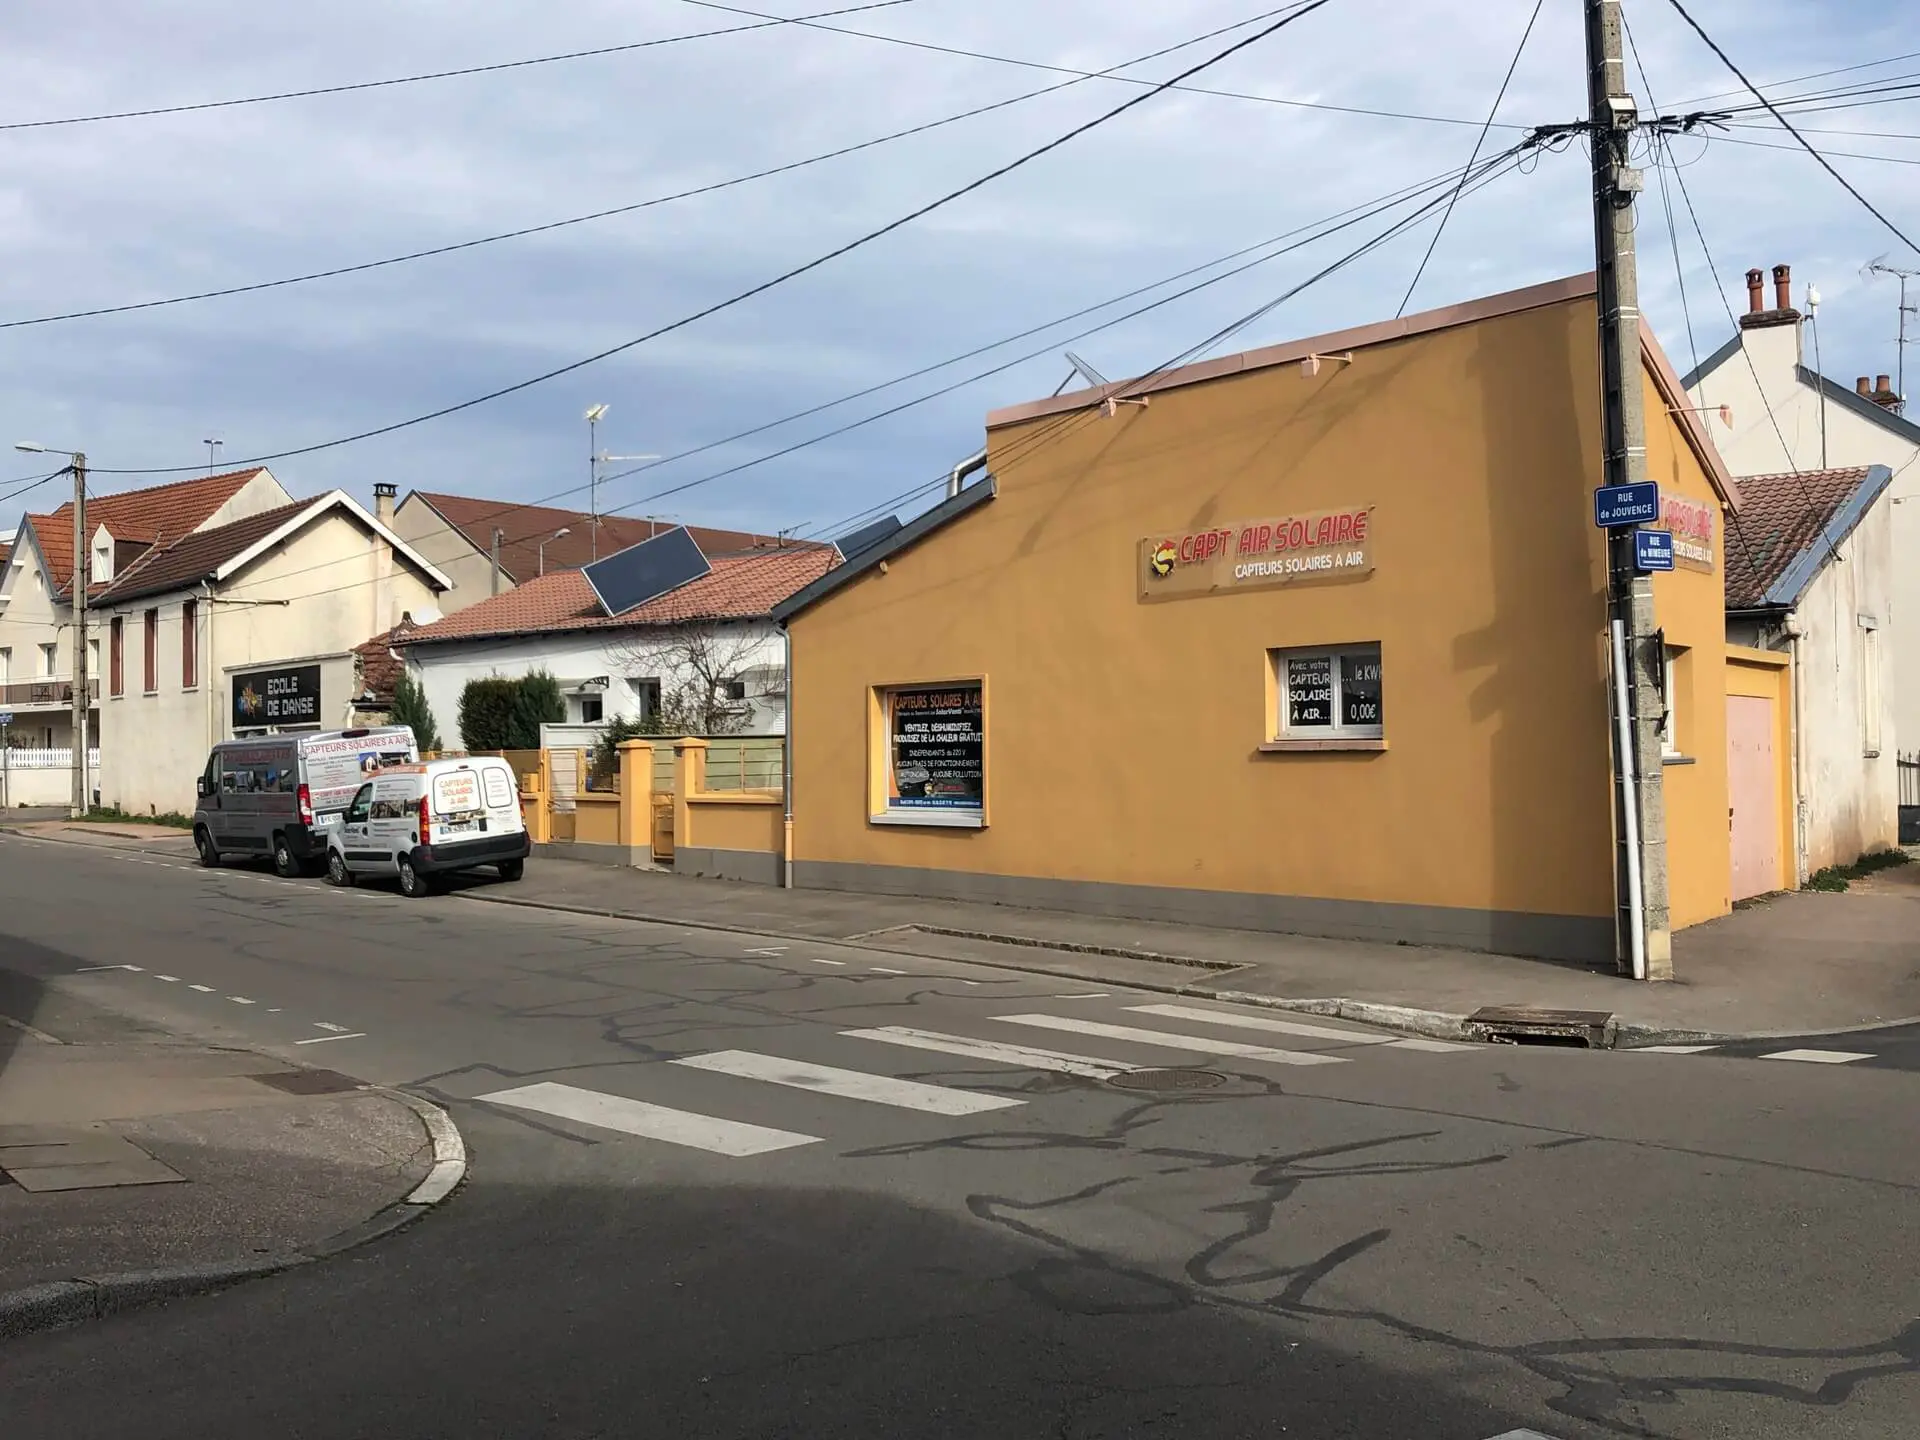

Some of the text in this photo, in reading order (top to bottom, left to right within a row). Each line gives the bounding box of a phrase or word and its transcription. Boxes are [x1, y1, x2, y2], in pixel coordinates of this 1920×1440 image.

[1617, 492, 1633, 503] RUE
[1600, 509, 1609, 519] de
[1612, 503, 1652, 518] JOUVENCE
[1180, 511, 1368, 563] CAPT AIR SOLAIRE
[1650, 536, 1660, 546] RUE
[1235, 551, 1363, 578] CAPTEURS SOLAIRES A AIR
[1290, 660, 1329, 670] Avec votre
[1355, 665, 1363, 681] le
[267, 676, 298, 695] ECOLE
[1289, 672, 1331, 686] CAPTEUR
[894, 695, 928, 710] CAPTEURS
[930, 692, 962, 708] SOLAIRES
[1290, 689, 1332, 702] SOLAIRE
[267, 699, 280, 716] DE
[282, 697, 314, 715] DANSE
[1292, 706, 1299, 720] À
[1350, 704, 1376, 721] 0,00€
[305, 742, 348, 754] CAPTEURS
[348, 736, 388, 750] SOLAIRES
[921, 733, 928, 743] DE
[928, 733, 935, 743] LA
[936, 733, 958, 743] CHALEUR
